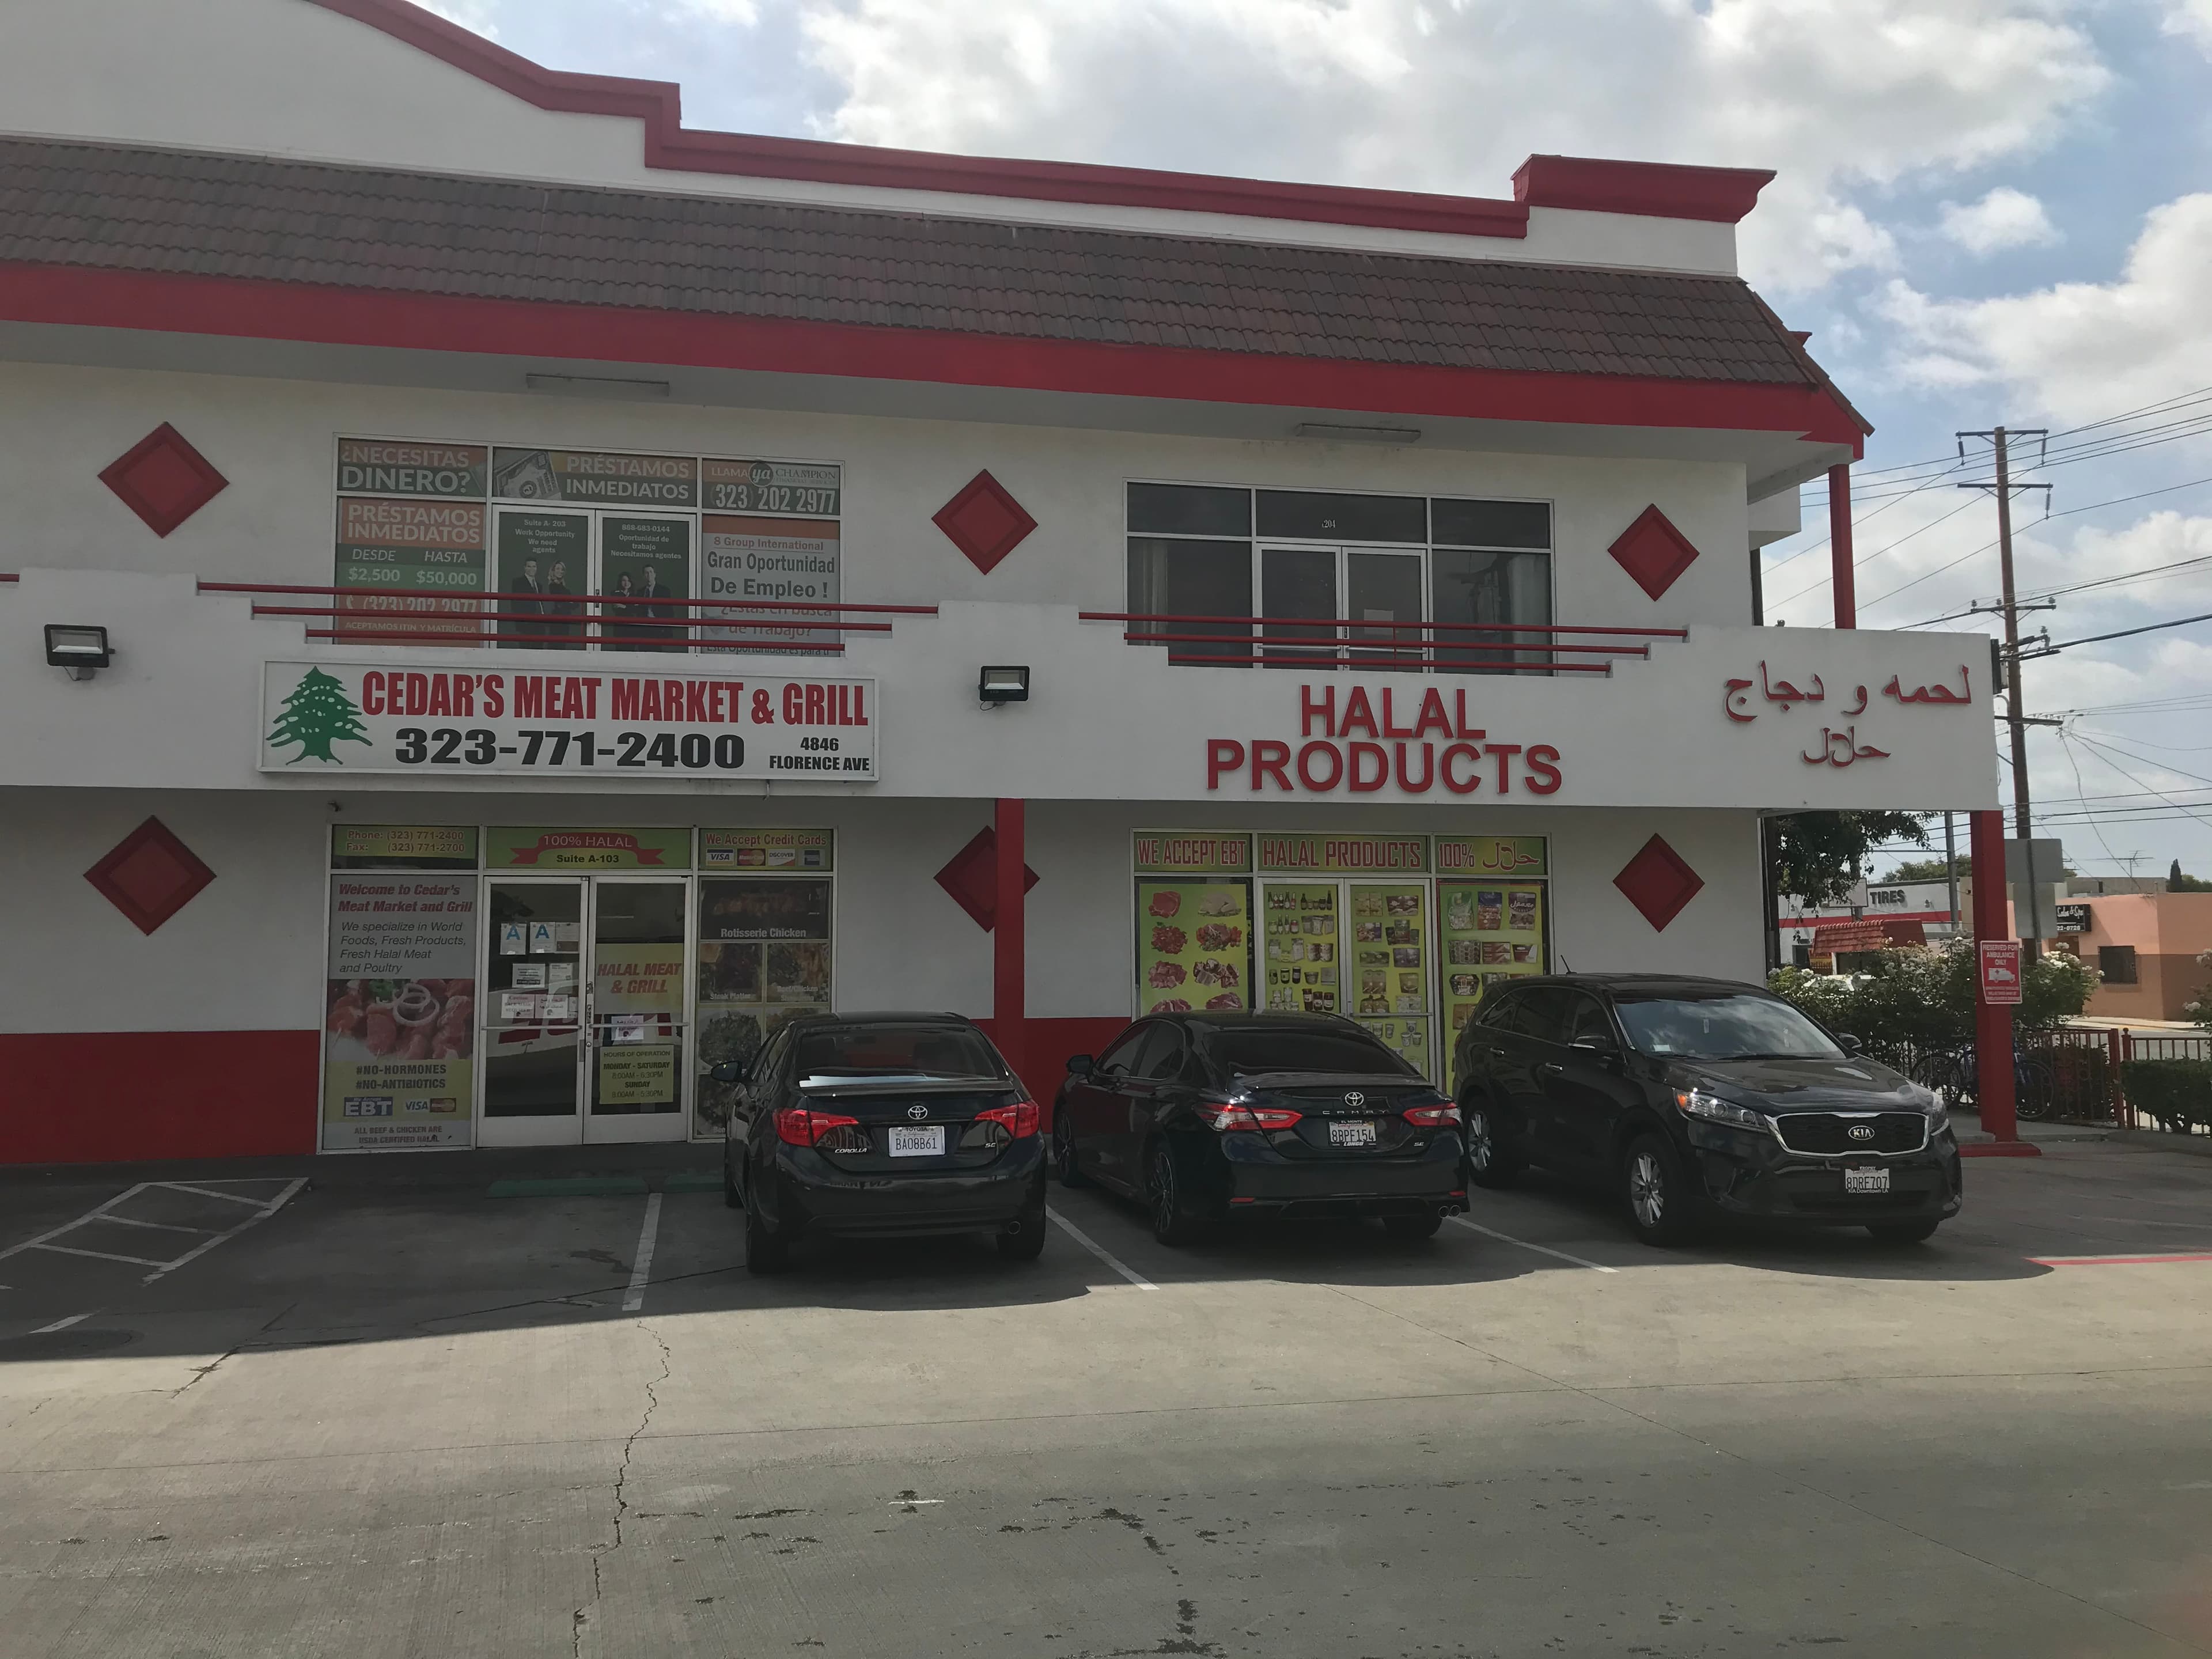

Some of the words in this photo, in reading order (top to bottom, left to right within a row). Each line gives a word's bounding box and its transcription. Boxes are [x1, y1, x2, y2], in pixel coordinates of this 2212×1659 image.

[340, 445, 469, 467] ¿NECESITAS
[566, 453, 689, 479] PRÉSTAMOS
[775, 468, 836, 479] CHAMPION
[342, 466, 470, 493] DINERO?
[711, 467, 748, 478] LLAMA
[752, 468, 771, 483] ya
[566, 478, 689, 499] INMEDIATOS
[758, 486, 790, 511] 202
[796, 488, 835, 513] 2977
[348, 502, 480, 527] PRÉSTAMOS
[347, 522, 480, 543] INMEDIATOS
[535, 529, 575, 539] Opportunity
[714, 536, 720, 546] 8
[724, 537, 755, 549] Group
[757, 539, 824, 551] International
[352, 548, 396, 562] DESDE
[425, 551, 467, 563] HASTA
[611, 550, 654, 558] Necesitamos
[707, 551, 741, 569] Gran
[746, 552, 835, 574] Oportunidad
[348, 567, 401, 582] $2,500
[416, 570, 477, 586] $50,000
[711, 577, 737, 594] De
[744, 578, 816, 599] Empleo
[822, 581, 828, 598] !
[345, 622, 398, 631] ACEPTAMOS
[399, 623, 416, 631] ITIN
[420, 623, 425, 631] Y
[1724, 659, 1825, 722] دجاج
[1881, 664, 1972, 704] لحمه
[362, 671, 505, 718] CEDAR'S
[513, 675, 603, 720] MEAT
[611, 679, 745, 724] MARKET
[751, 688, 775, 725] &
[782, 682, 869, 726] GRILL
[1841, 684, 1868, 715] و
[1300, 684, 1487, 739] HALAL
[395, 728, 745, 770] 323-771-2400
[800, 736, 840, 752] 4846
[1801, 725, 1892, 768] حلال
[769, 755, 840, 770] FLORENCE
[843, 757, 870, 771] AVE
[1207, 738, 1563, 795] PRODUCTS
[348, 831, 383, 840] Phone:
[387, 831, 414, 841] (323)
[417, 831, 464, 840] 771-2400
[544, 835, 582, 847] 100%
[586, 836, 632, 847] HALAL
[706, 834, 721, 845] We
[725, 834, 761, 847] Accept
[764, 834, 794, 845] Credit
[797, 834, 827, 845] Cards
[346, 842, 369, 851] Fax:
[387, 843, 414, 853] (323)
[418, 843, 465, 852] 771-2700
[1137, 839, 1160, 865] WE
[1163, 839, 1217, 865] ACCEPT
[1221, 839, 1246, 865] EBT
[1262, 839, 1320, 867] HALAL
[1325, 840, 1422, 869] PRODUCTS
[556, 854, 585, 863] Suite
[588, 854, 620, 863] A-103
[1439, 842, 1475, 869] 100%
[1481, 840, 1541, 871] حلال
[338, 884, 395, 895] Welcome
[399, 884, 411, 895] to
[414, 884, 460, 895] Cedar's
[1869, 889, 1906, 904] TIRES
[338, 900, 370, 912] Meat
[373, 900, 418, 912] Market
[420, 901, 444, 912] and
[446, 901, 473, 912] Grill
[342, 922, 359, 931] We
[363, 922, 415, 933] specialize
[418, 922, 427, 931] in
[431, 922, 463, 931] World
[506, 924, 521, 940] A
[535, 924, 550, 939] A
[721, 928, 767, 938] Rotisserie
[769, 927, 806, 938] Chicken
[340, 935, 378, 946] Foods,
[381, 935, 412, 945] Fresh
[415, 935, 467, 946] Products,
[340, 949, 370, 959] Fresh
[374, 949, 401, 959] Halal
[404, 949, 432, 959] Meat
[339, 963, 360, 972] and
[363, 963, 403, 974] Poultry
[597, 963, 640, 976] HALAL
[643, 963, 682, 975] MEAT
[611, 980, 623, 994] &
[627, 979, 669, 993] GRILL
[356, 1065, 446, 1075] #NO-HORMONES
[603, 1062, 631, 1070] MONDAY
[355, 1078, 446, 1089] #NO-ANTIBIOTICS
[346, 1101, 392, 1116] EBT
[406, 1101, 429, 1110] VISA
[380, 1136, 415, 1144] CERTIFIED
[1332, 1129, 1374, 1142] 8BPF154
[1853, 1128, 1871, 1137] KIA
[1847, 1176, 1888, 1189] 8DRF707
